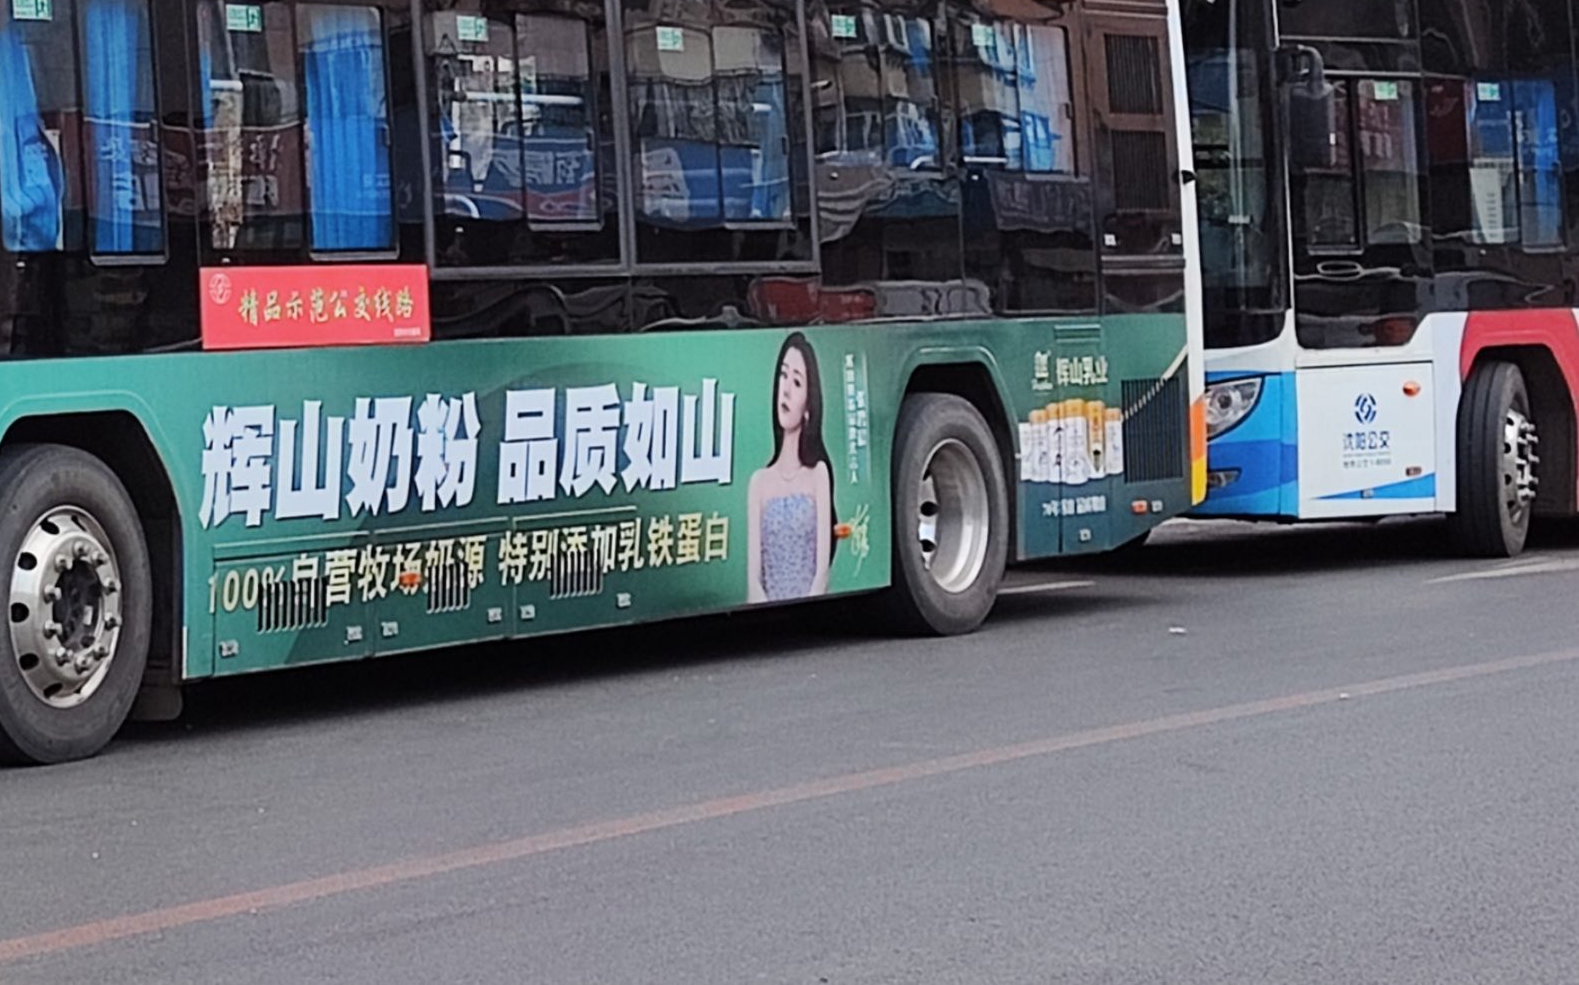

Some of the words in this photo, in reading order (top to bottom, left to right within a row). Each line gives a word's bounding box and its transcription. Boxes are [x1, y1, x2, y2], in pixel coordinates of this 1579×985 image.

[237, 285, 415, 327] 精品示范公交线路
[1055, 355, 1109, 387] 辉山乳业
[197, 390, 483, 530] 辉山奶粉
[497, 377, 737, 505] 品质如山
[497, 511, 731, 586] 特别添加乳铁蛋白
